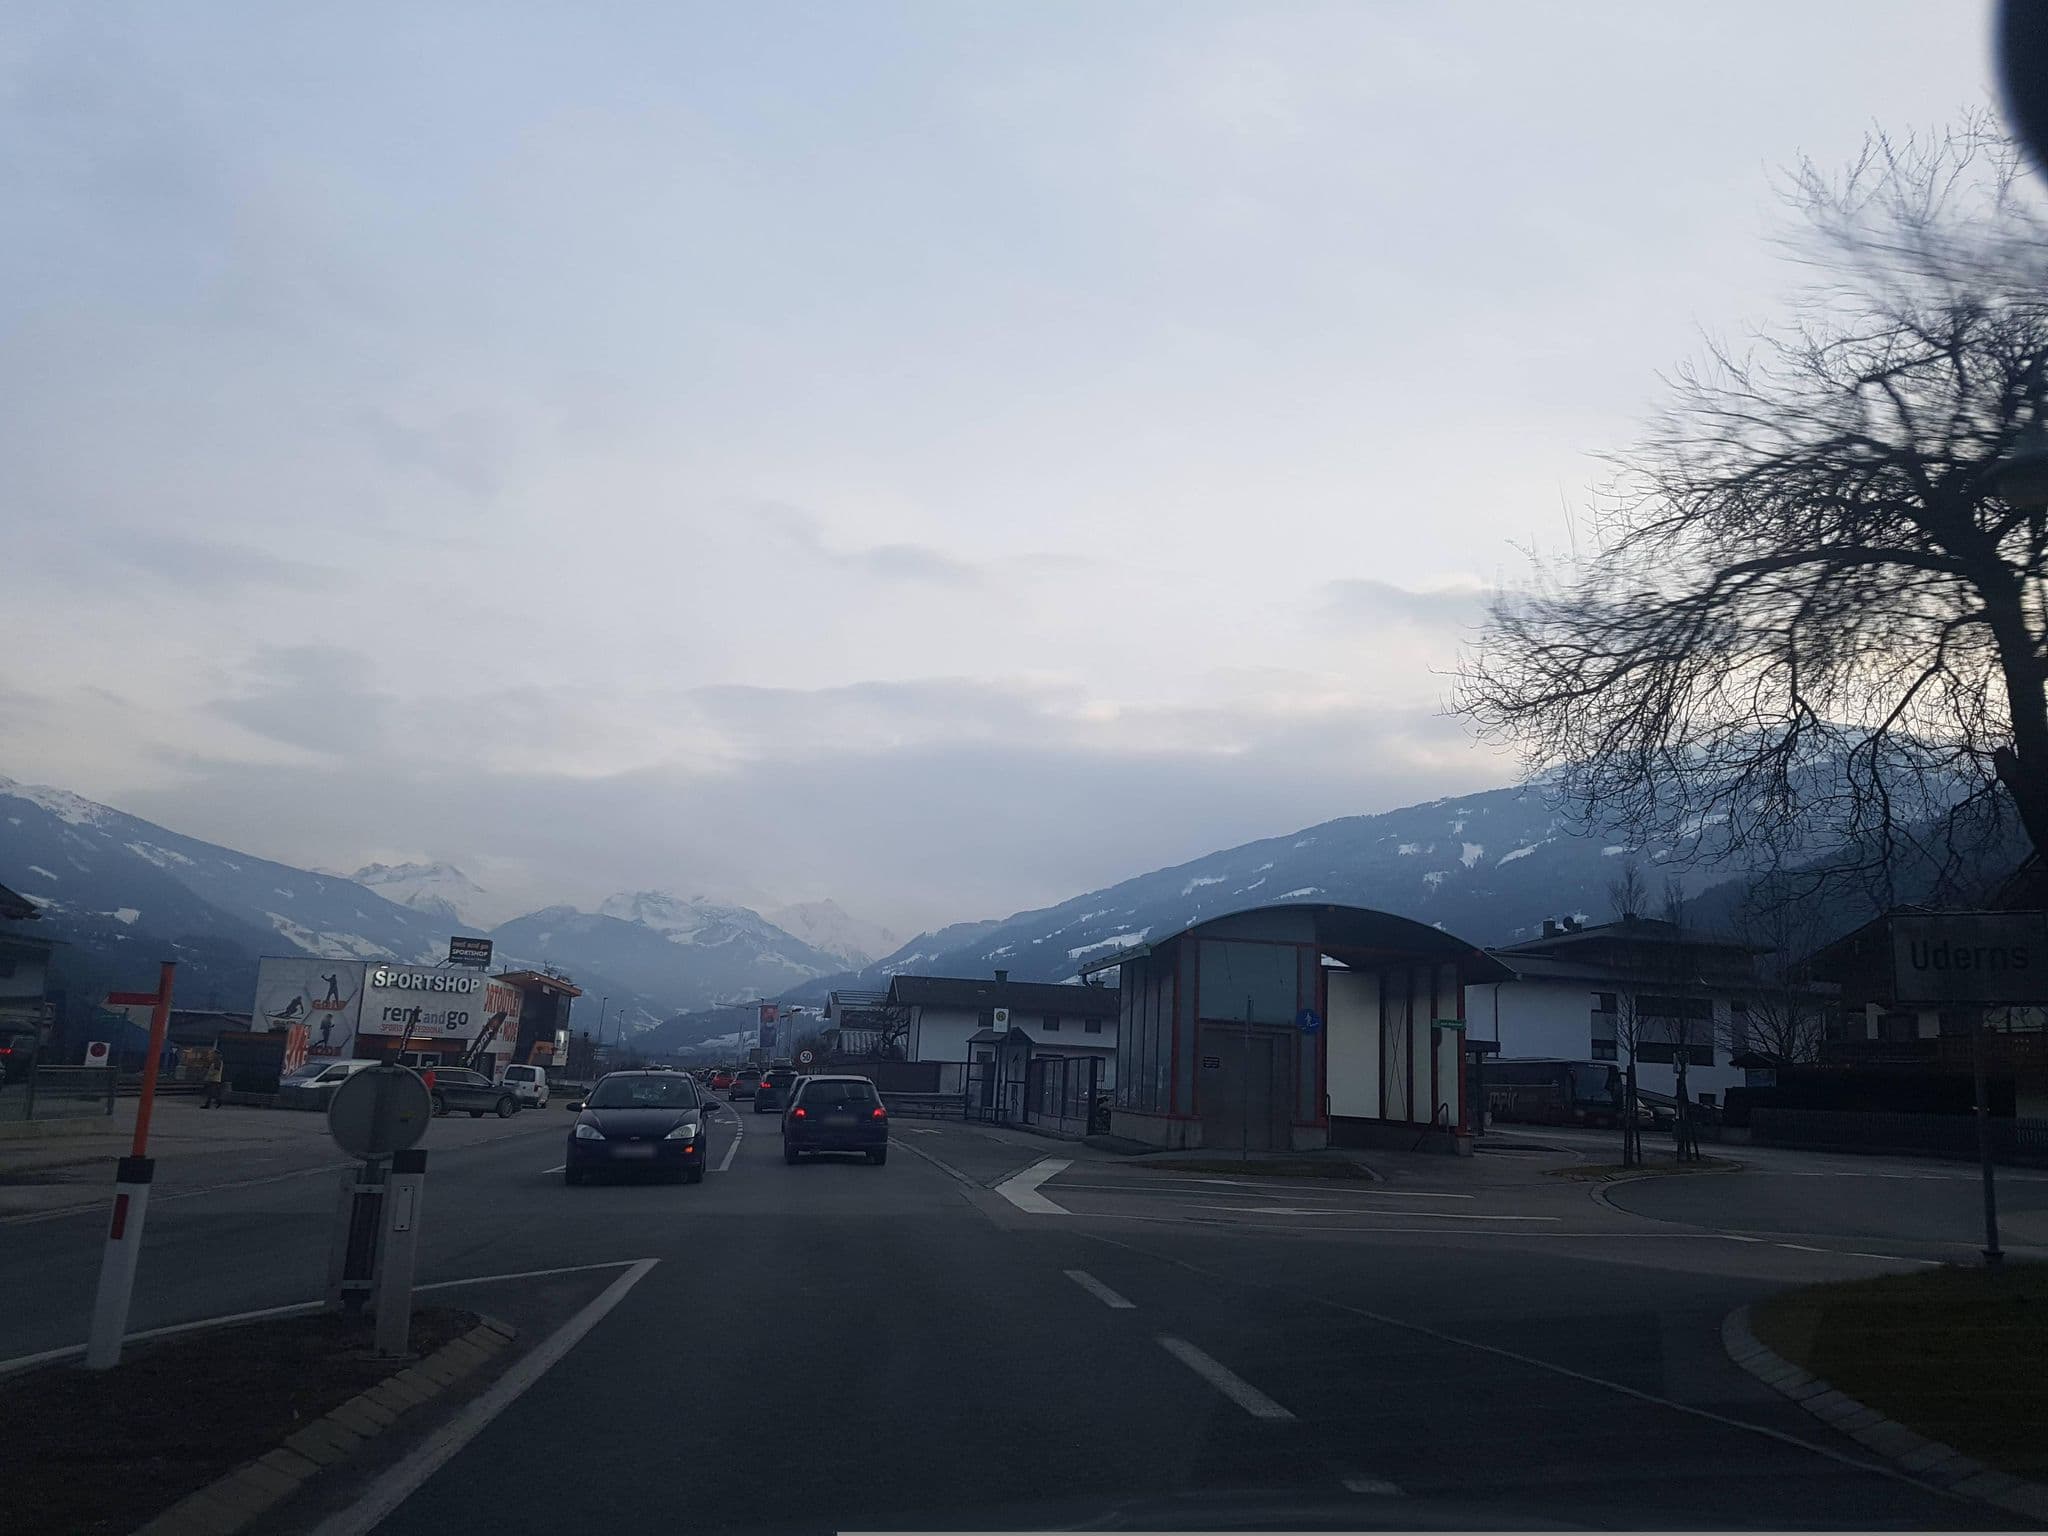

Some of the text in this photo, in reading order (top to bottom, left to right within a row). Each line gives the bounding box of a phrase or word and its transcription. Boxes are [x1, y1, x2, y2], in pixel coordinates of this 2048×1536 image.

[1911, 940, 2029, 970] Uderns
[374, 970, 481, 993] SPORTSHOP
[383, 1006, 469, 1030] rent and go
[802, 1053, 811, 1061] 50
